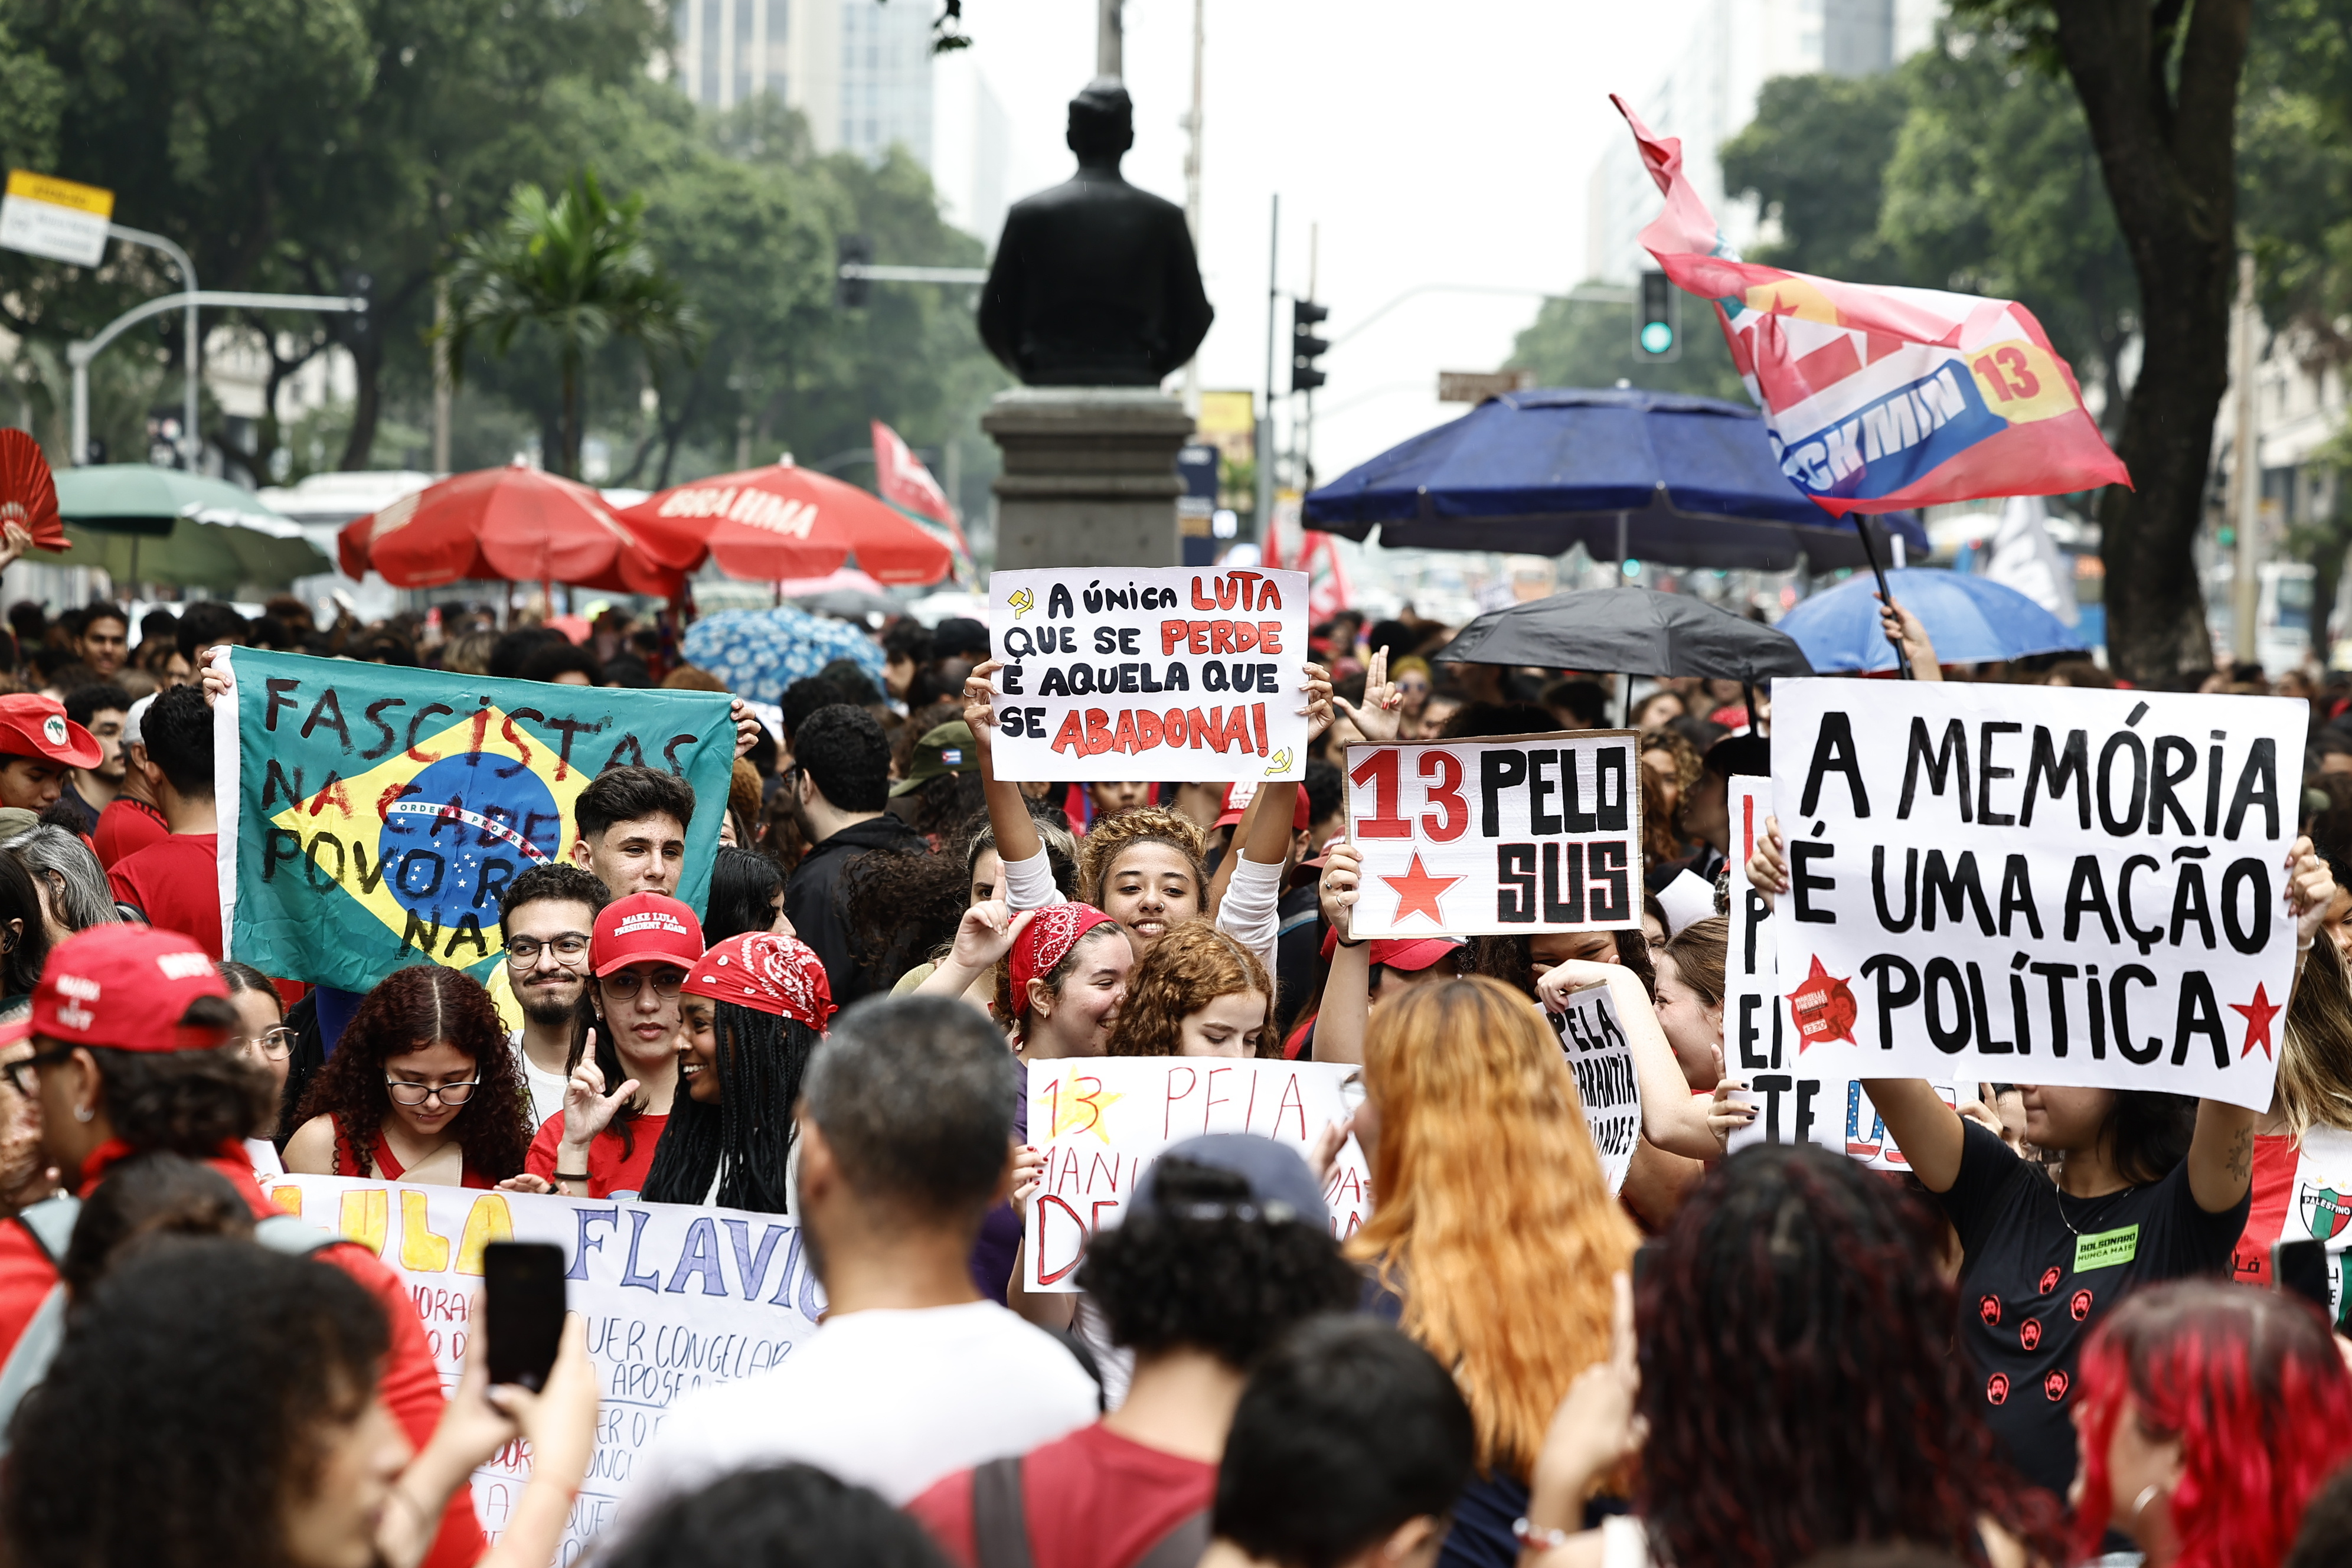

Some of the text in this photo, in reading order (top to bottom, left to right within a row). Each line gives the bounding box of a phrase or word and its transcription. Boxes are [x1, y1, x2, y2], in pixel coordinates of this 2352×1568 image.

[1974, 347, 2041, 402] 13
[658, 486, 819, 540] BRAHMA
[1048, 571, 1282, 619] A ÚNICA LUTA
[1004, 619, 1282, 658] QUE SE PERDE
[1002, 658, 1279, 697] É AQUELA QUE
[999, 702, 1268, 759] SE ABADONA!
[1349, 746, 1628, 844] 13 PELO
[1799, 711, 1870, 818] A
[1897, 700, 2281, 841] MEMÓRIA
[261, 759, 562, 861] NA CADE
[400, 804, 445, 814] ORDEM
[261, 828, 445, 901] POVO
[1497, 840, 1631, 923] SUS
[1791, 821, 1837, 925] É
[1872, 844, 2044, 939] UMA
[2063, 845, 2272, 955] AÇÃO
[399, 904, 489, 960] NA
[614, 922, 687, 936] PRESIDENT AGAIN
[622, 912, 679, 926] MAKE LULA
[1546, 998, 1625, 1053] PELA
[1805, 1022, 1825, 1034] 1330
[1860, 951, 2230, 1069] POLÍTICA
[1043, 1067, 1305, 1141] 13 PELA
[2304, 1196, 2350, 1215] PALESTINO
[2077, 1243, 2135, 1262] NUNCA MAIS!
[2080, 1233, 2135, 1253] BOLSONARO
